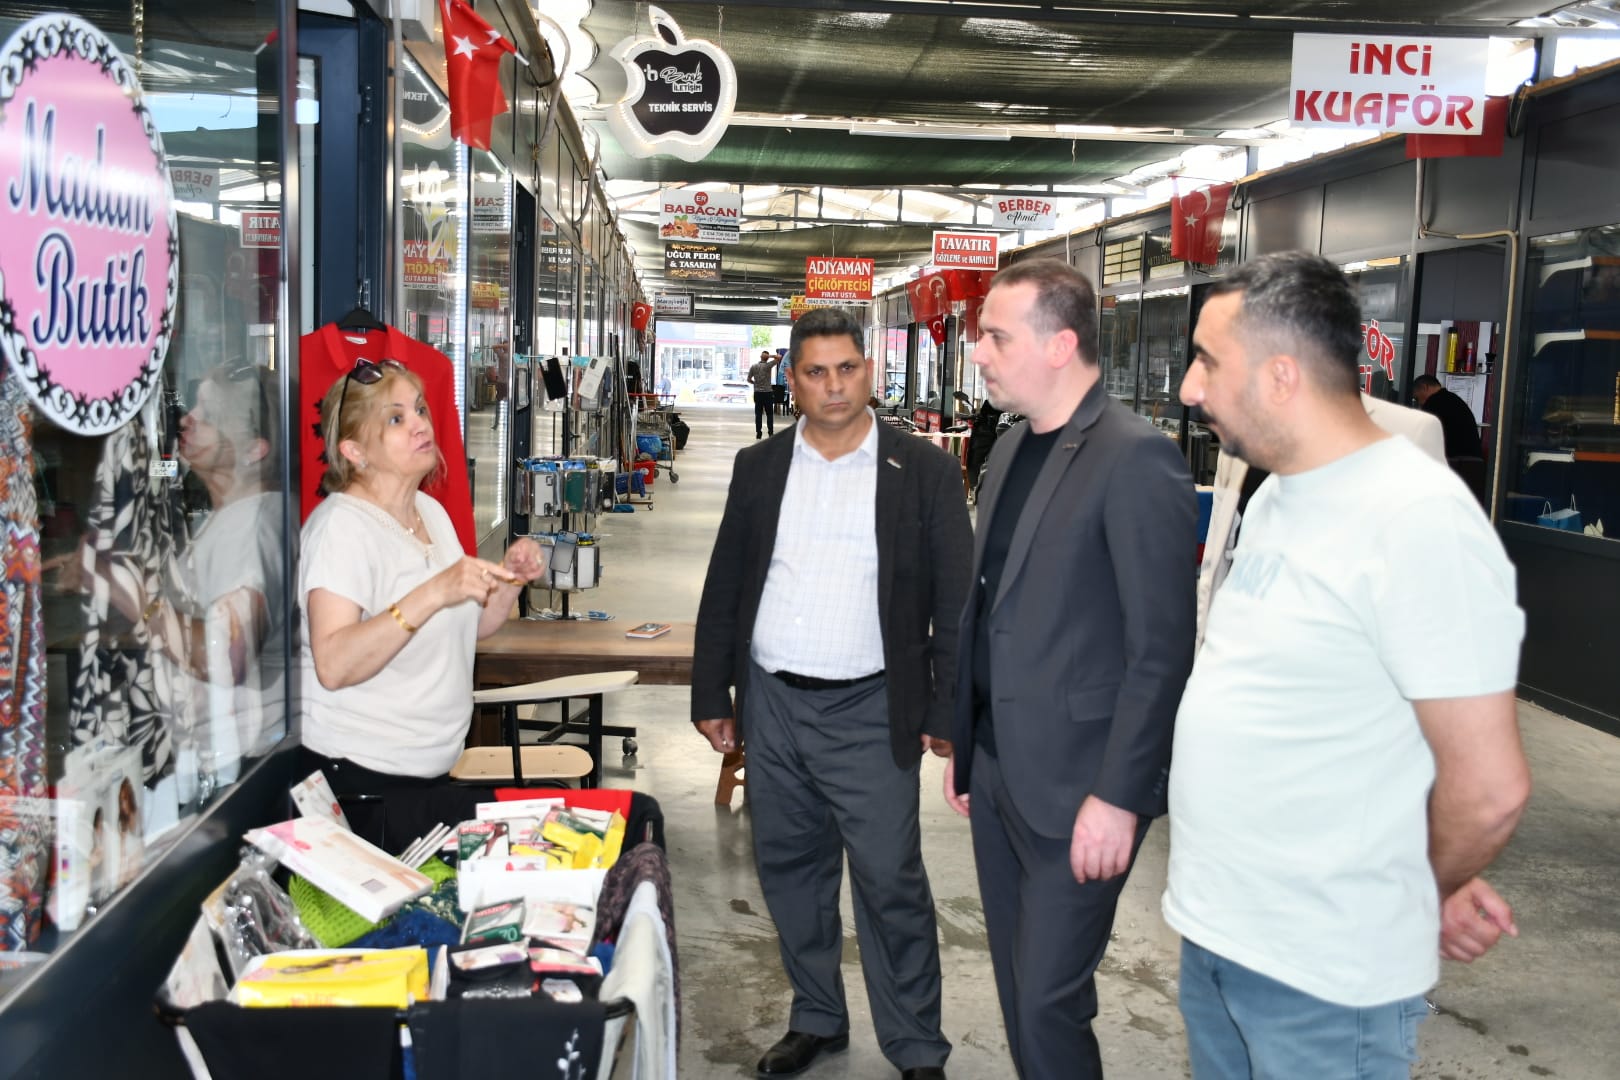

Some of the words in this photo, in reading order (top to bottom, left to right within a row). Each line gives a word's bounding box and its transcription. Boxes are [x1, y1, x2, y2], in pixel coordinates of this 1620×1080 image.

[648, 101, 680, 112] TEKNİK
[681, 101, 713, 112] SERVİS
[1294, 84, 1474, 130] KUAFÖR
[9, 100, 155, 235] Madam
[664, 203, 738, 217] BABACAN
[998, 198, 1052, 215] BERBER
[1006, 211, 1039, 226] Ahmet
[939, 237, 992, 252] TAVATIR
[666, 250, 692, 260] UĞUR
[693, 252, 721, 260] PERDE
[669, 260, 677, 268] &
[680, 261, 717, 269] TASARIM
[807, 259, 872, 276] ADIYAMAN
[32, 232, 151, 345] Butik
[808, 277, 871, 293] ÇİĞKÖFTECİSİ
